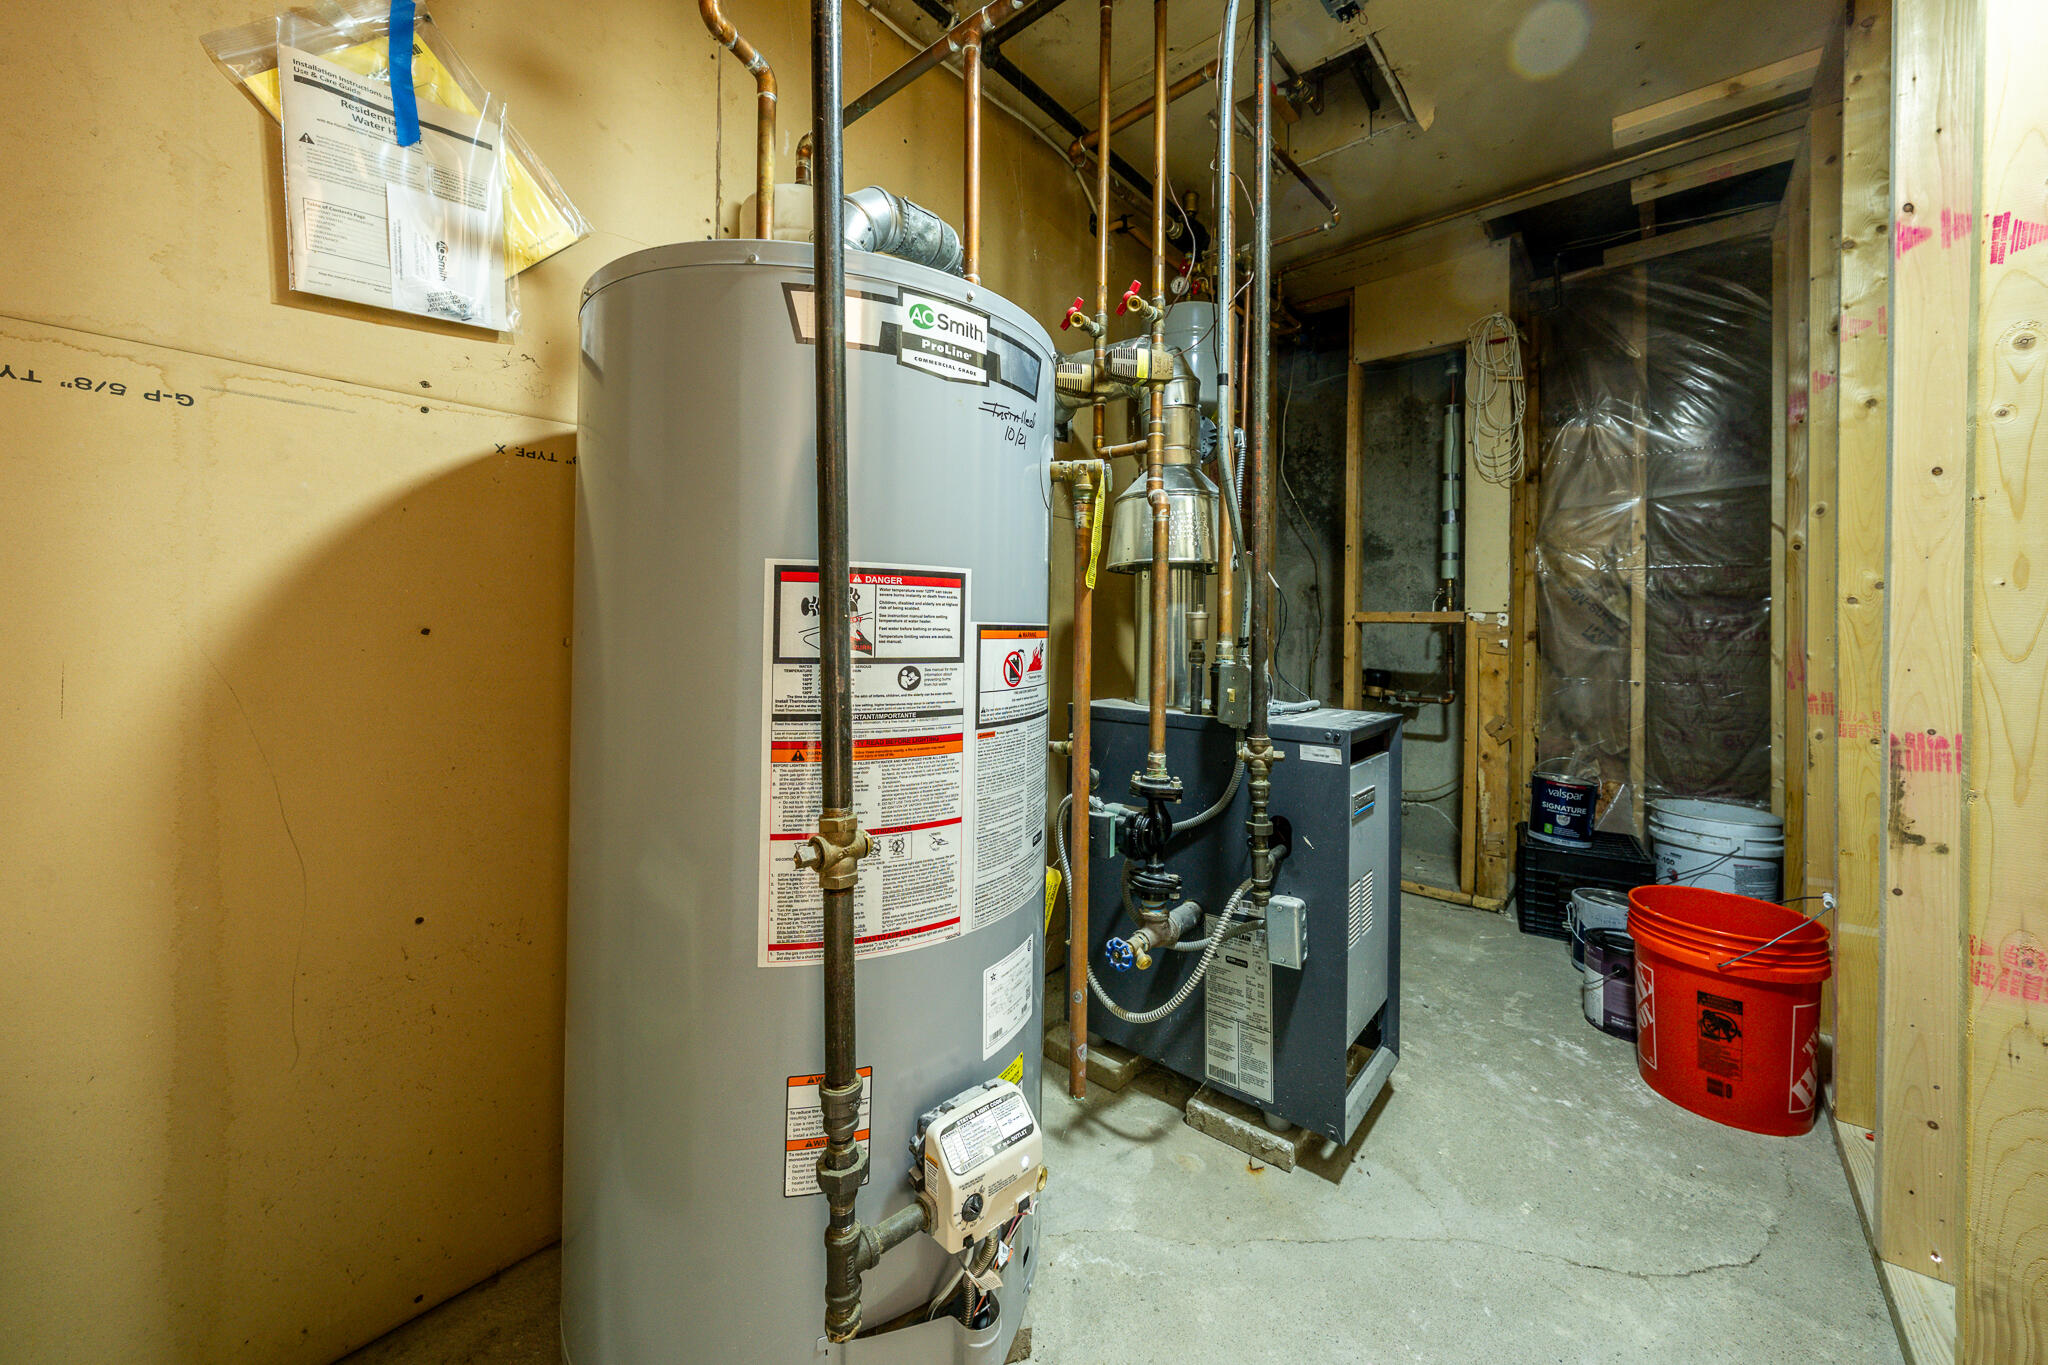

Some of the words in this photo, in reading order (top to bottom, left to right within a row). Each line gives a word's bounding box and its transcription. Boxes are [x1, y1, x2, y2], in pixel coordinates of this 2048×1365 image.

[293, 58, 338, 80] Installation
[339, 75, 382, 97] Instructions
[383, 93, 392, 101] an
[293, 66, 309, 76] Use
[310, 71, 318, 79] &
[319, 74, 337, 86] Care
[338, 82, 361, 95] Guide
[340, 99, 396, 126] Residentia
[351, 113, 385, 132] Water
[921, 339, 970, 361] ProLine
[914, 356, 956, 371] COMMERCIAL
[958, 367, 977, 377] GRADE
[143, 389, 195, 407] G-P
[494, 443, 506, 455] X
[515, 446, 558, 463] TYPE
[865, 575, 903, 585] DANGER
[1547, 788, 1585, 801] valspar
[1541, 801, 1587, 815] SIGNATURE
